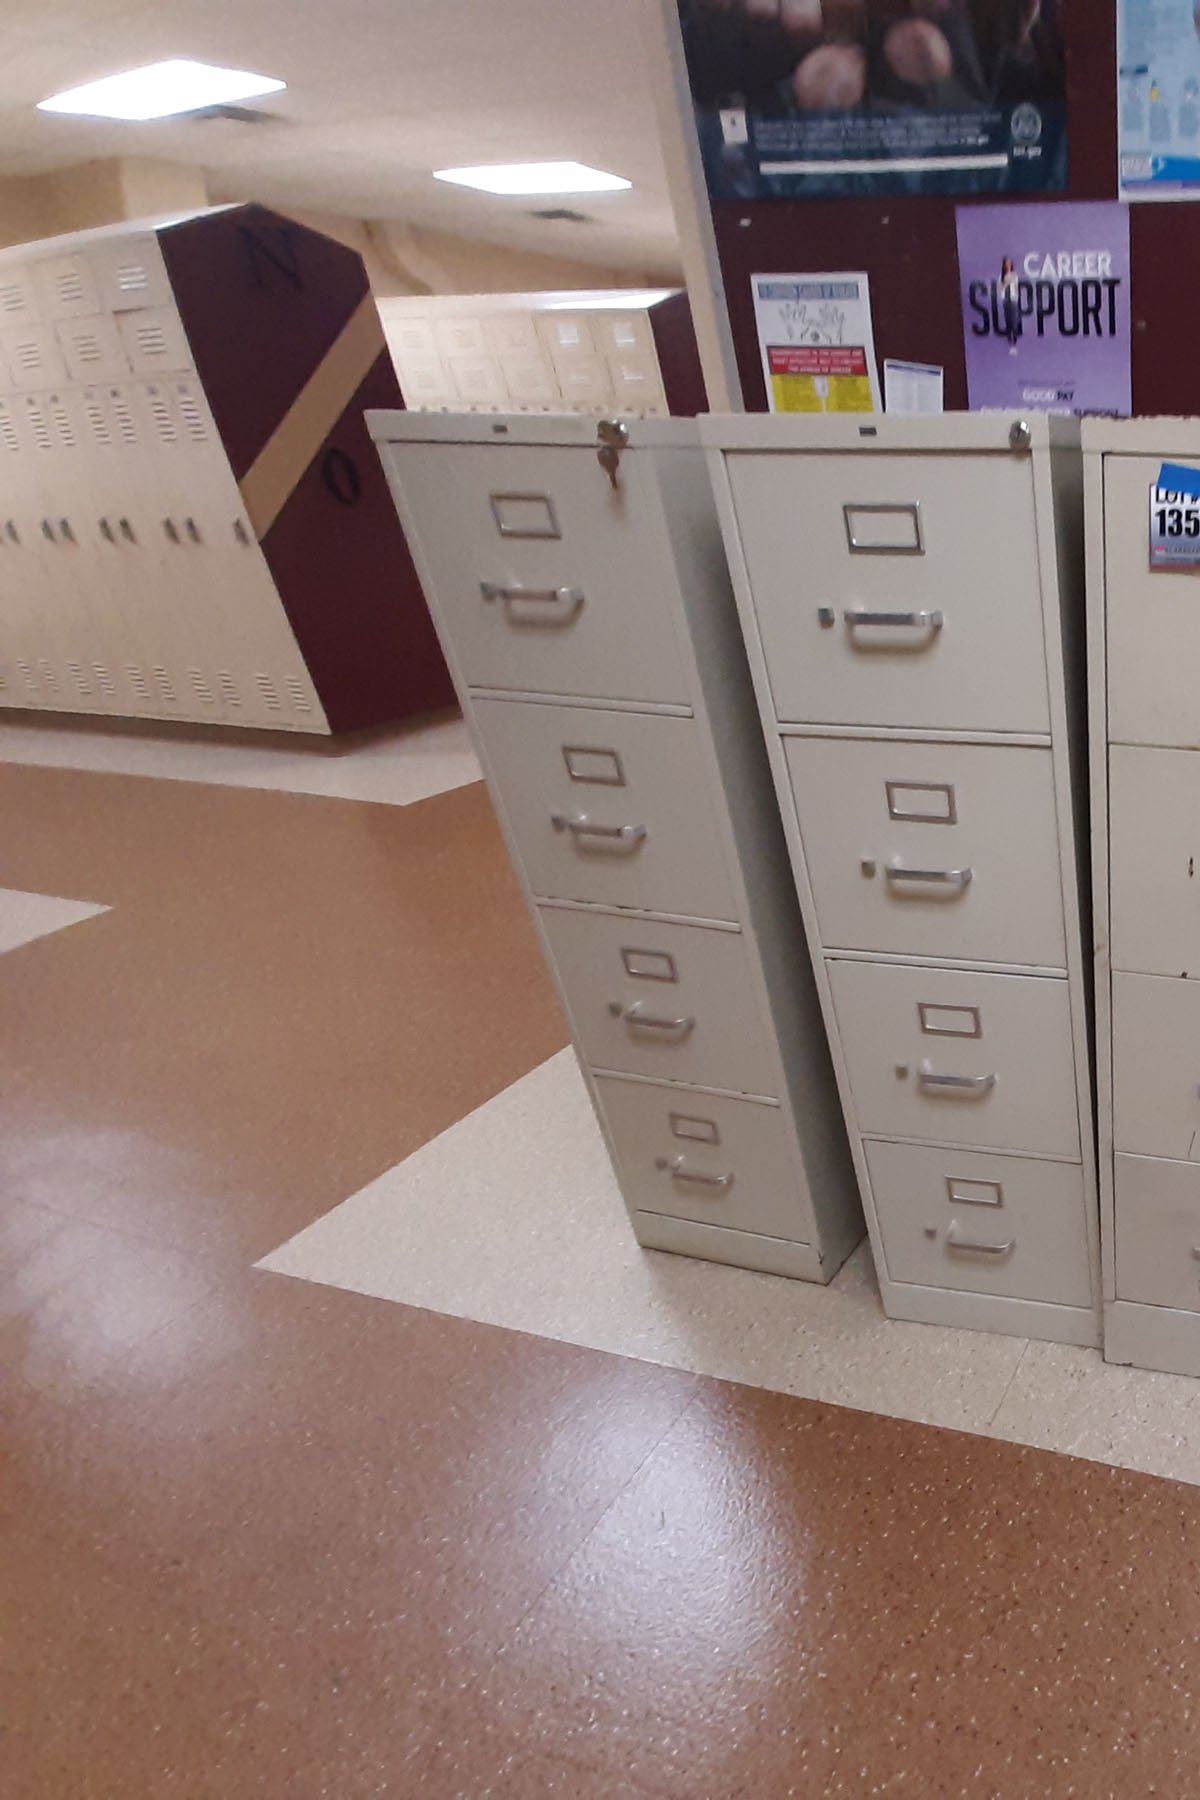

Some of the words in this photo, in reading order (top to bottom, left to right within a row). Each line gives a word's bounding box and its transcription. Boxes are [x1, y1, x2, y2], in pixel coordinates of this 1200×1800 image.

[1023, 251, 1112, 279] CAREER
[968, 277, 1121, 337] SUPPORT
[1155, 508, 1200, 538] 135
